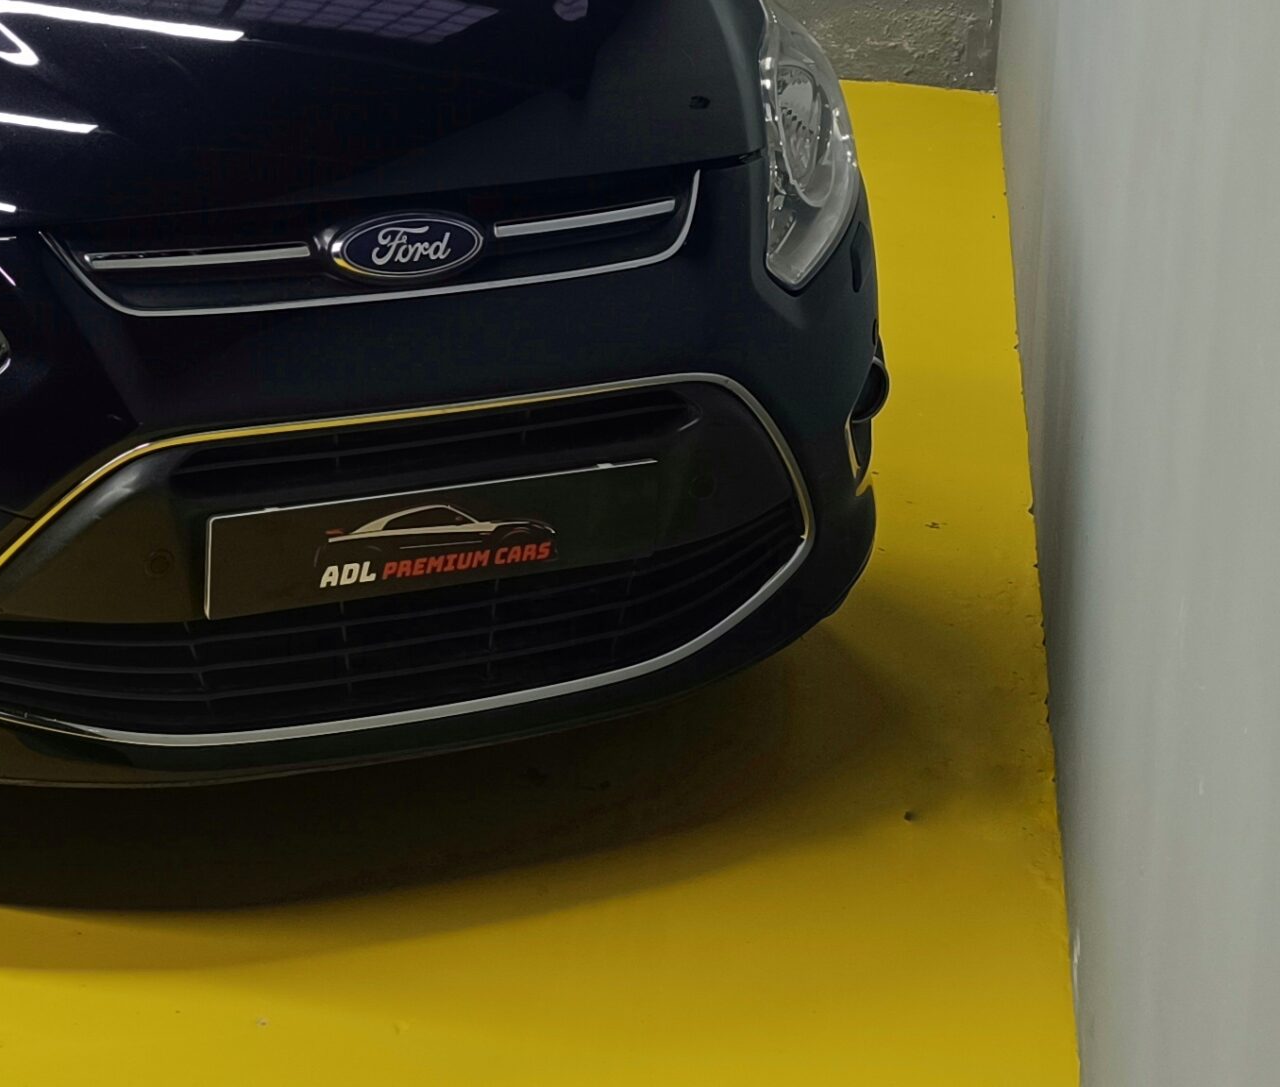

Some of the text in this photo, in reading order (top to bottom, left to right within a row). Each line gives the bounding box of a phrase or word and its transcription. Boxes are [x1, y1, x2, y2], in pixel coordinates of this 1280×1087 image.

[372, 225, 451, 265] Ford
[319, 541, 551, 588] ADL PREMIUM CARS
